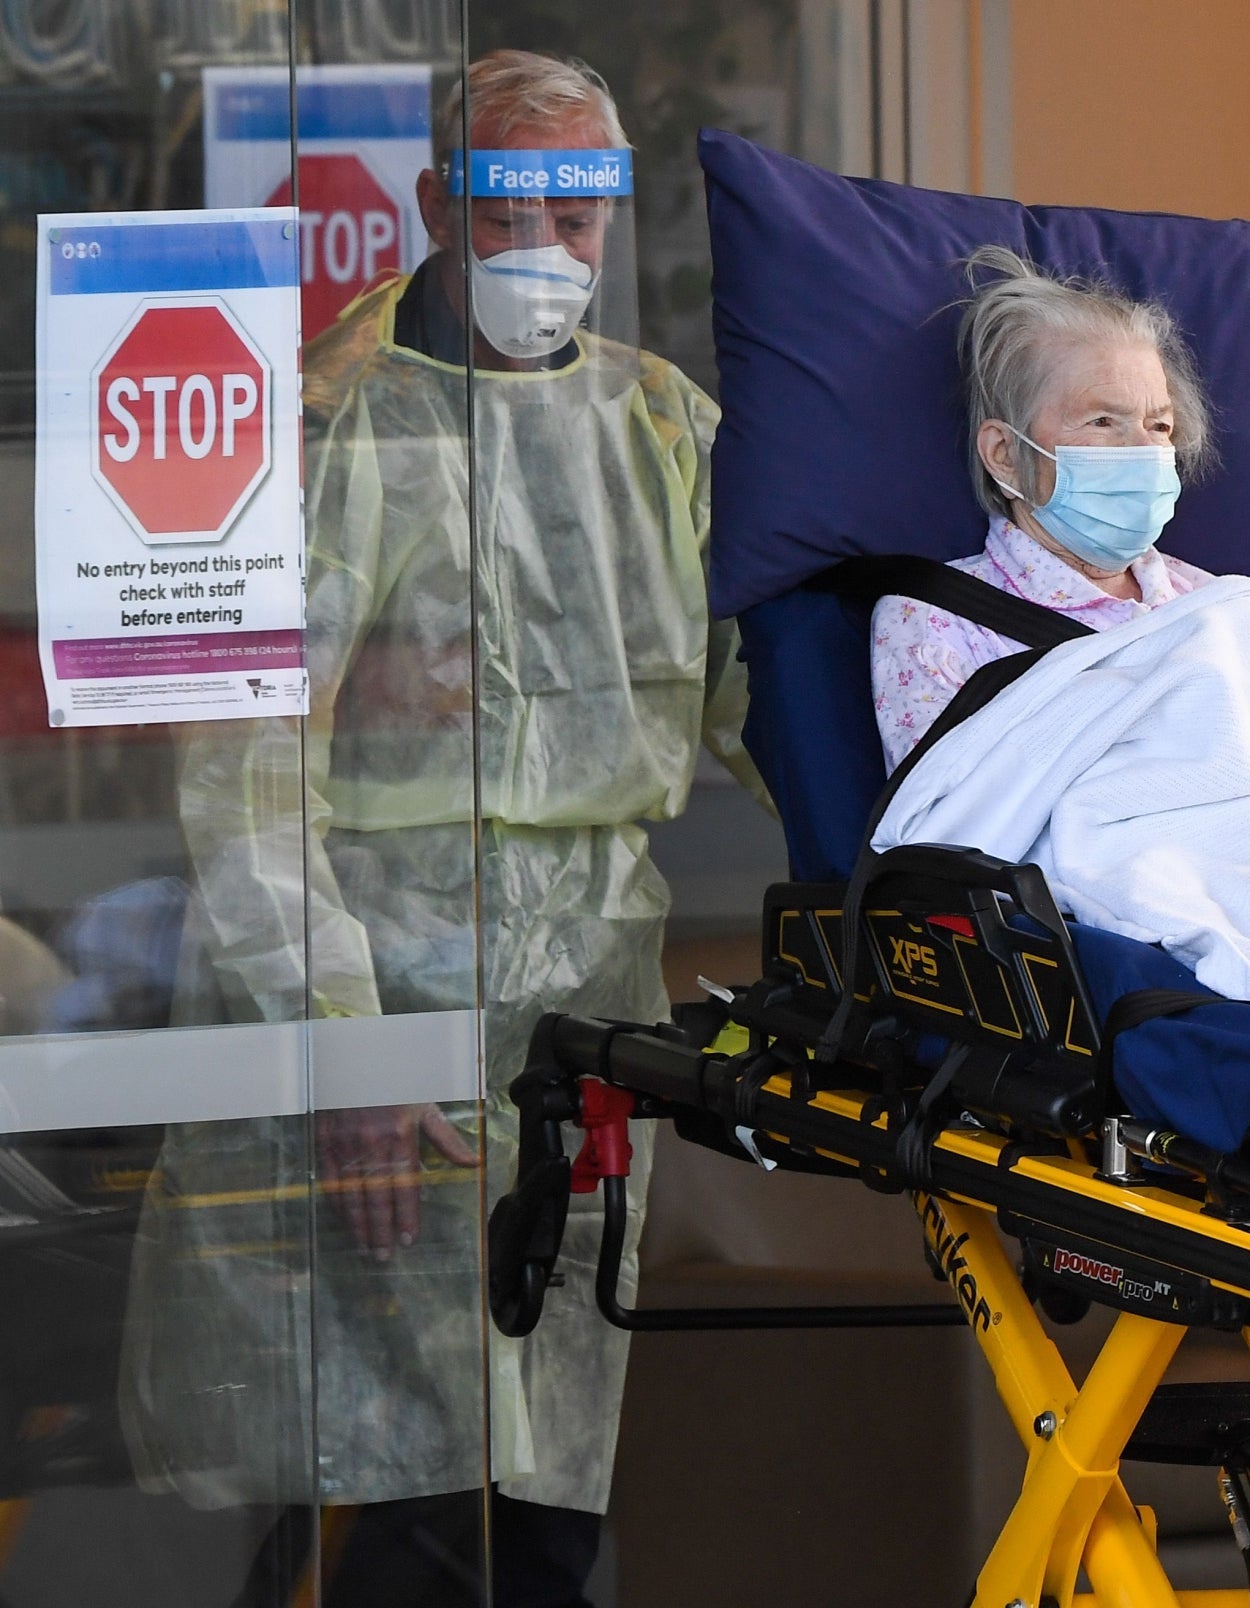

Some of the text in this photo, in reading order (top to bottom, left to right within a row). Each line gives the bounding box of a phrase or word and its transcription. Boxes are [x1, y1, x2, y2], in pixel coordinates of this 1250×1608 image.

[488, 163, 620, 188] Face Shield
[299, 209, 395, 284] TOP
[104, 373, 258, 463] STOP
[77, 554, 285, 579] No entry beyond this point
[119, 579, 246, 602] check with staff
[121, 606, 243, 627] before entering
[888, 935, 938, 977] XPS
[1054, 1247, 1172, 1302] power pro XT
